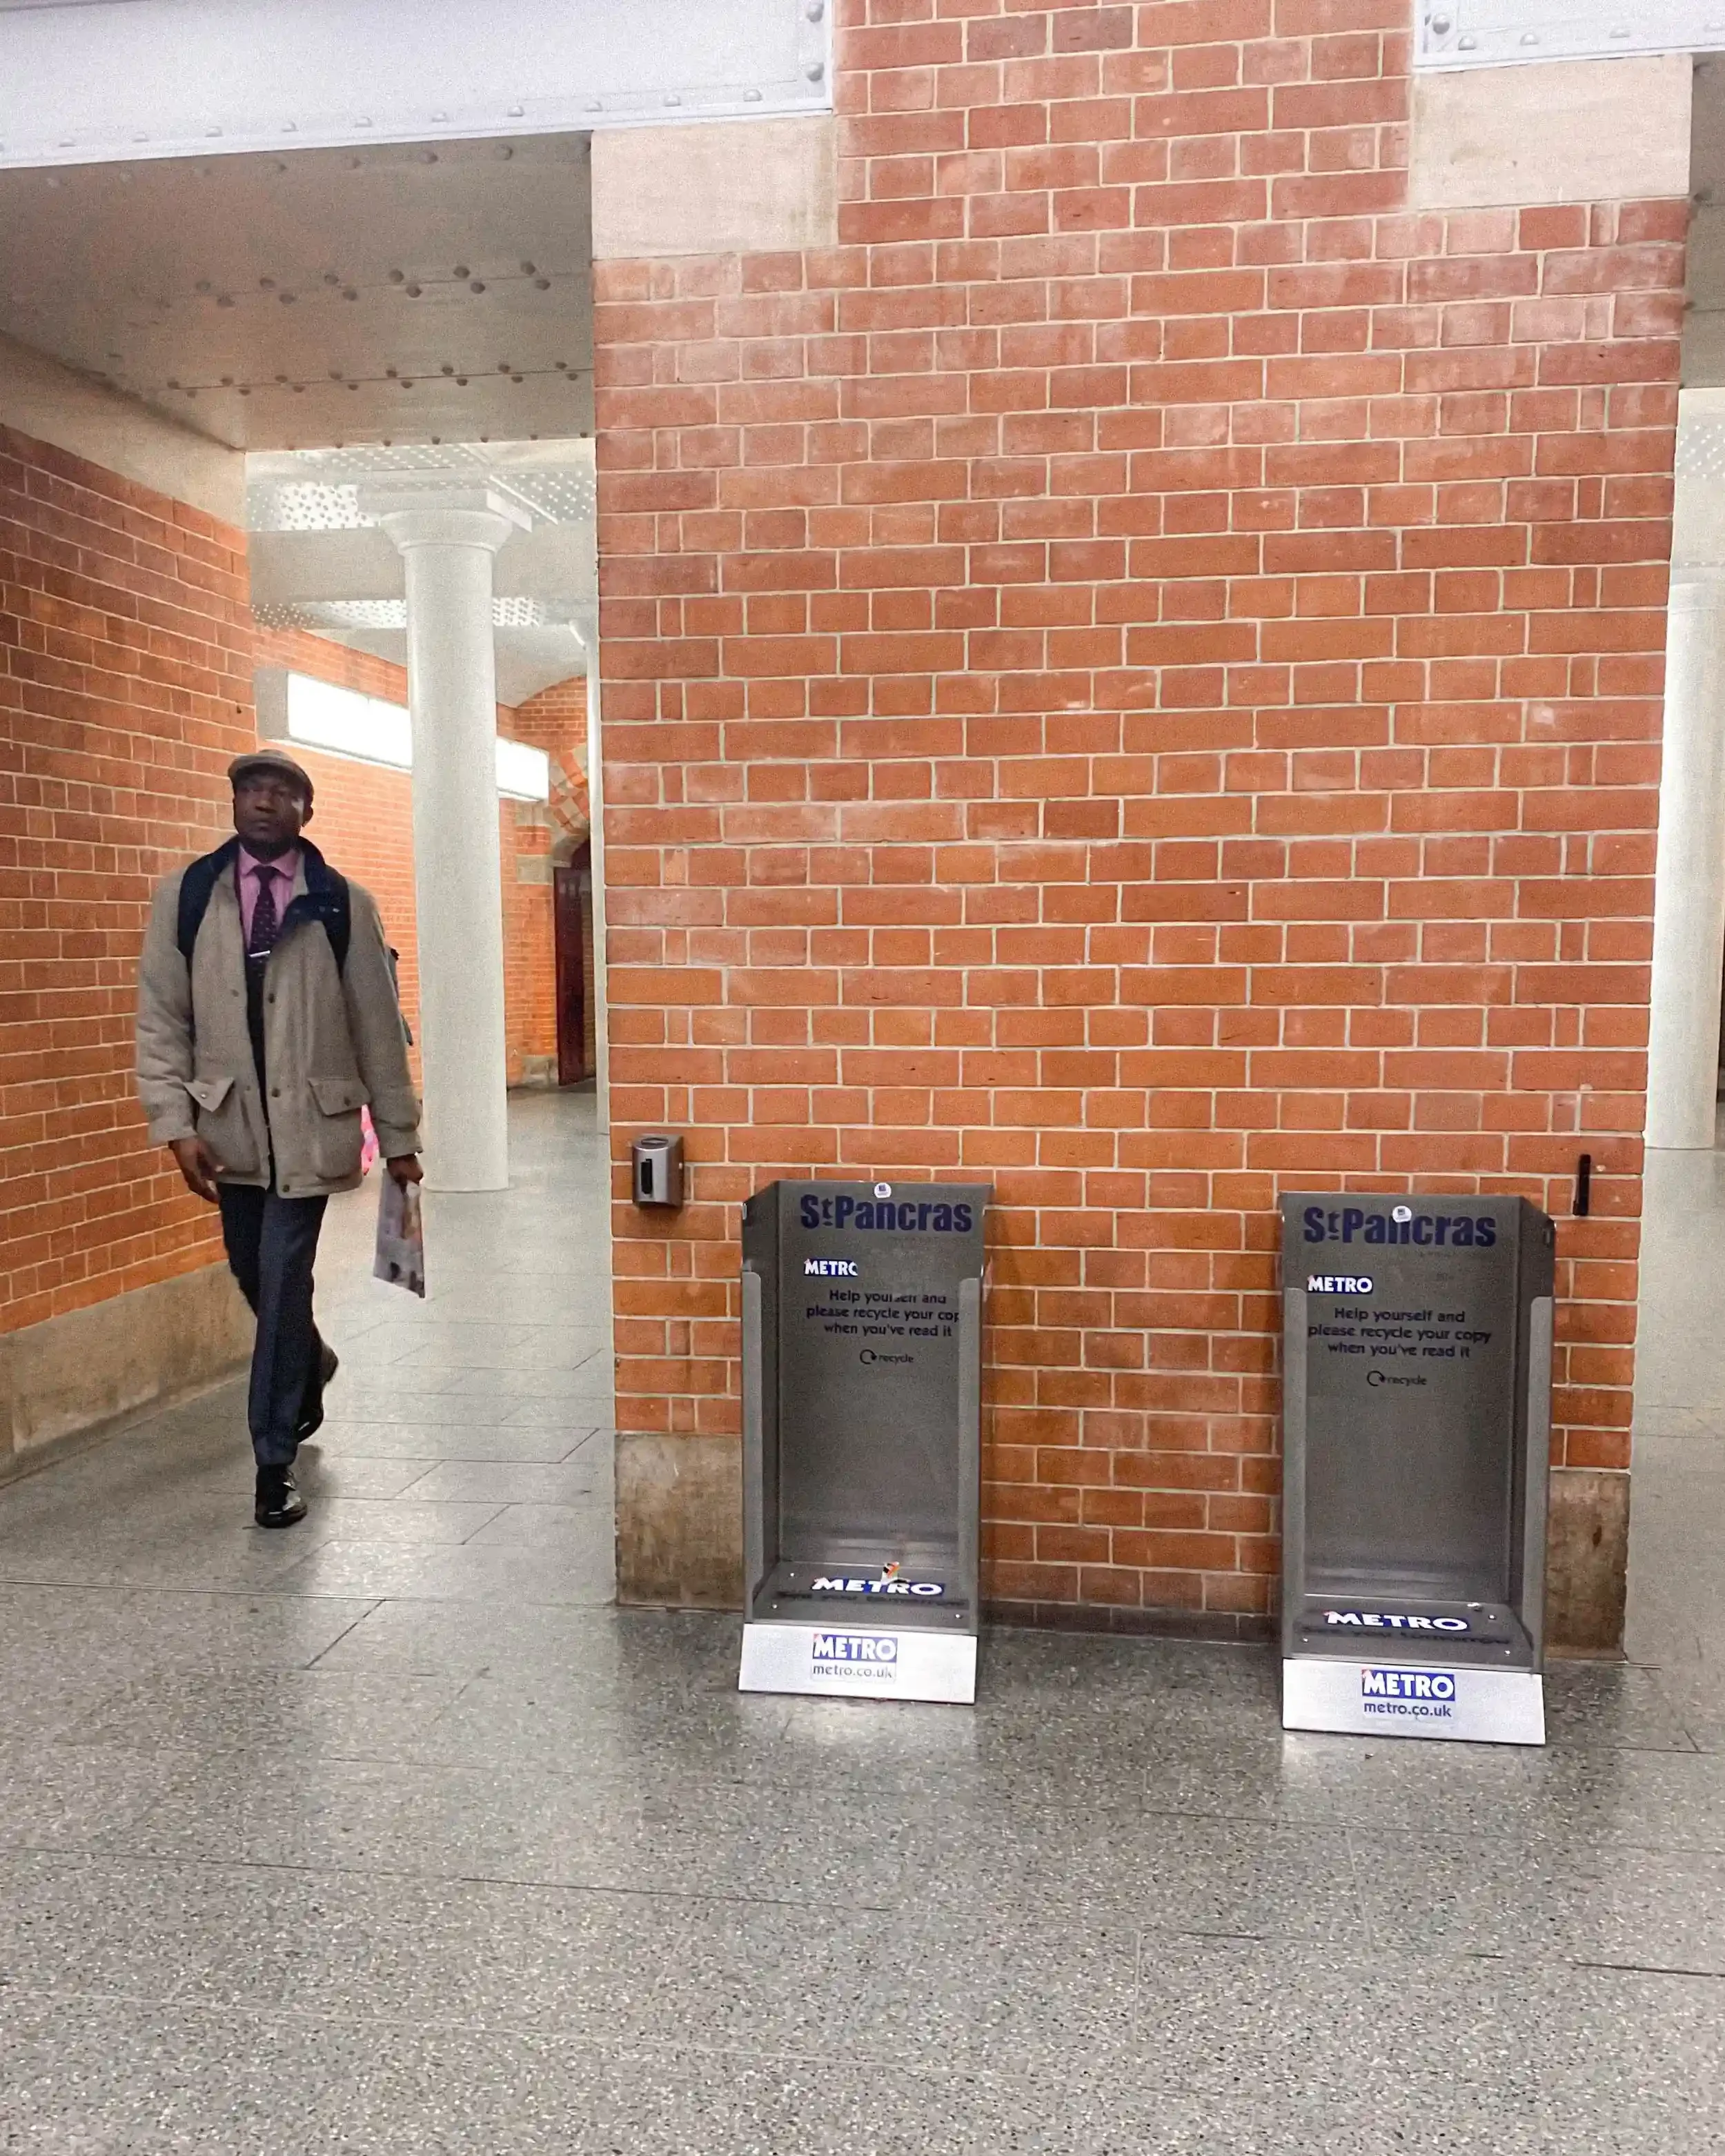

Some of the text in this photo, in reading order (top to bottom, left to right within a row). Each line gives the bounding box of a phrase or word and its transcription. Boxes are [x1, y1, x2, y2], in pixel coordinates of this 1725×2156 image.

[1308, 1275, 1373, 1293] METRO
[829, 1289, 860, 1304] Help
[807, 1305, 849, 1318] please
[854, 1307, 900, 1321] recycle
[904, 1310, 933, 1321] your
[1334, 1308, 1465, 1323] Help yourself and
[825, 1322, 952, 1337] when you've read it
[1308, 1325, 1491, 1344] please recycle your copy
[1328, 1342, 1470, 1358] when you've read it
[878, 1353, 914, 1365] recycle
[1387, 1374, 1427, 1386] recycle
[811, 1577, 943, 1595] METRO
[1323, 1610, 1468, 1630] METRO
[814, 1634, 897, 1661] METRO
[813, 1664, 892, 1679] metro.co.uk
[1362, 1670, 1454, 1699] METRO
[1363, 1702, 1452, 1717] metro.co.uk
